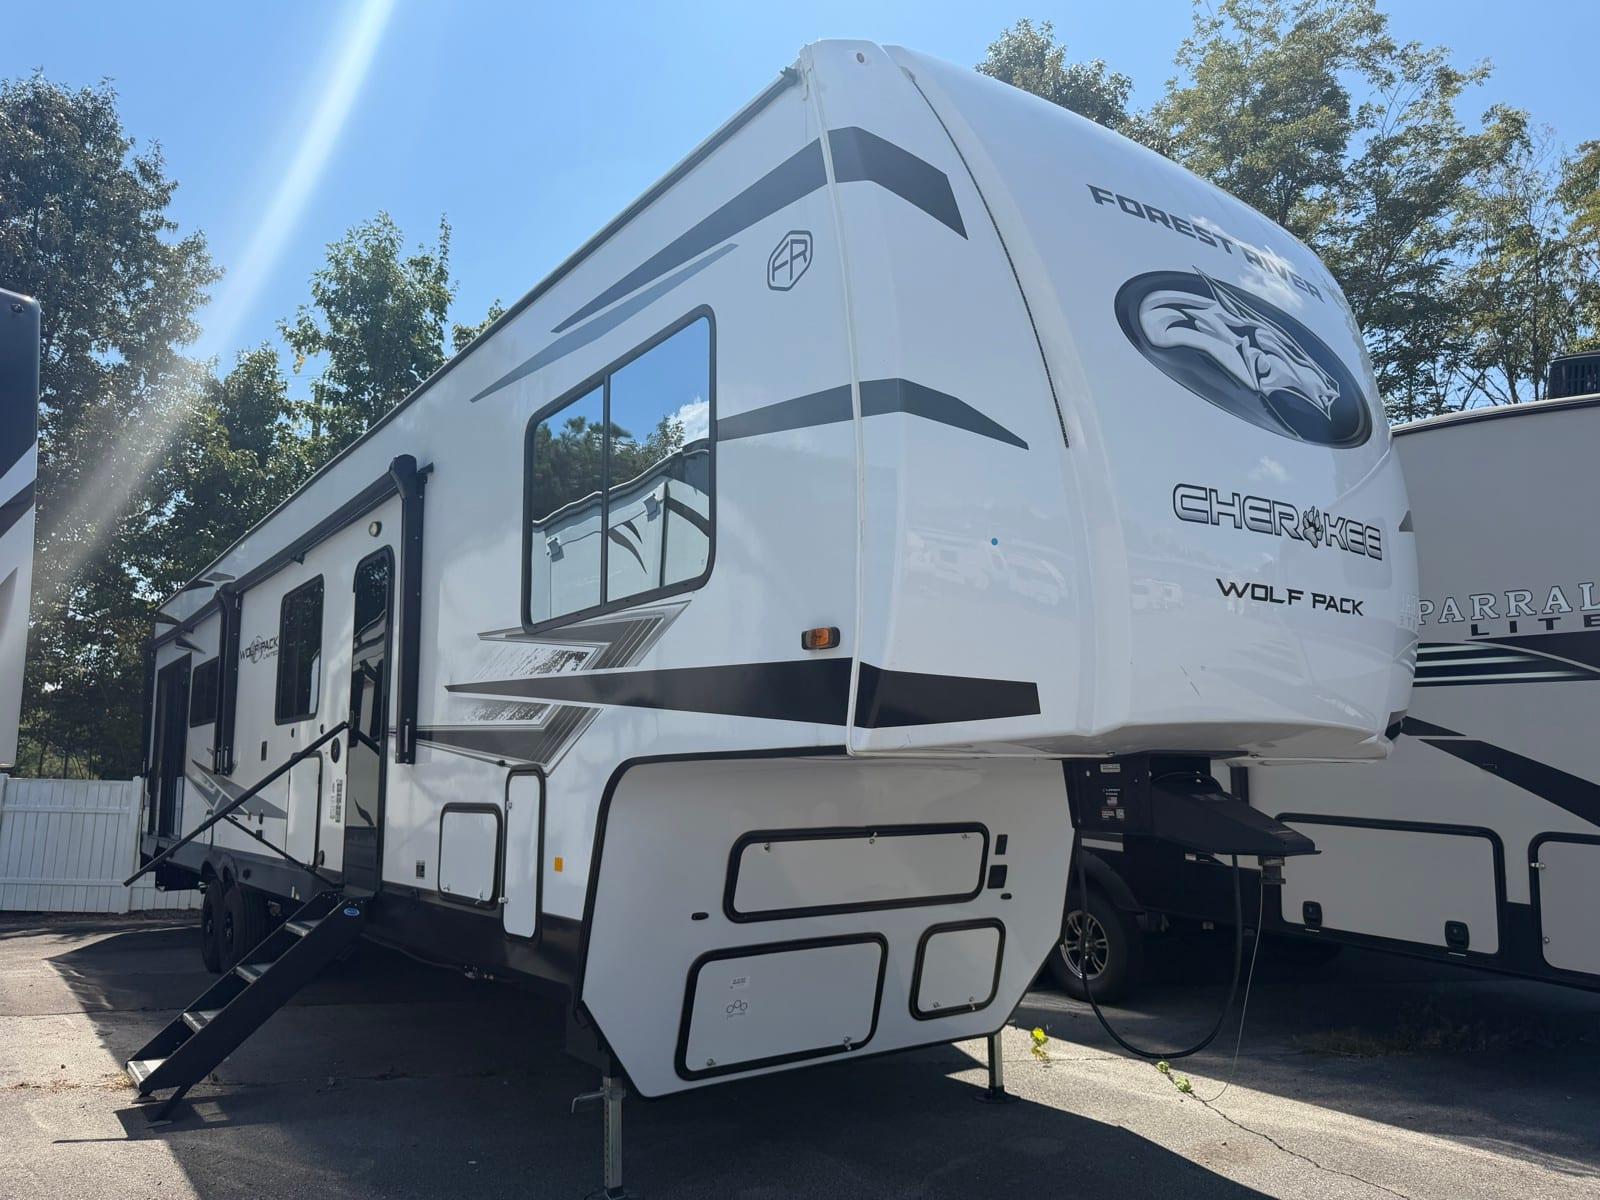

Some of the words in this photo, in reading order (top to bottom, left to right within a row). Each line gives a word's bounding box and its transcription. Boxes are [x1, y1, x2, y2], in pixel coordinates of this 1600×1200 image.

[1086, 183, 1234, 255] FOREST
[1241, 247, 1326, 304] RIVER
[1216, 578, 1304, 605] WOLF
[1311, 592, 1364, 616] PACK
[1470, 614, 1600, 637] LITE
[261, 635, 279, 651] PACK
